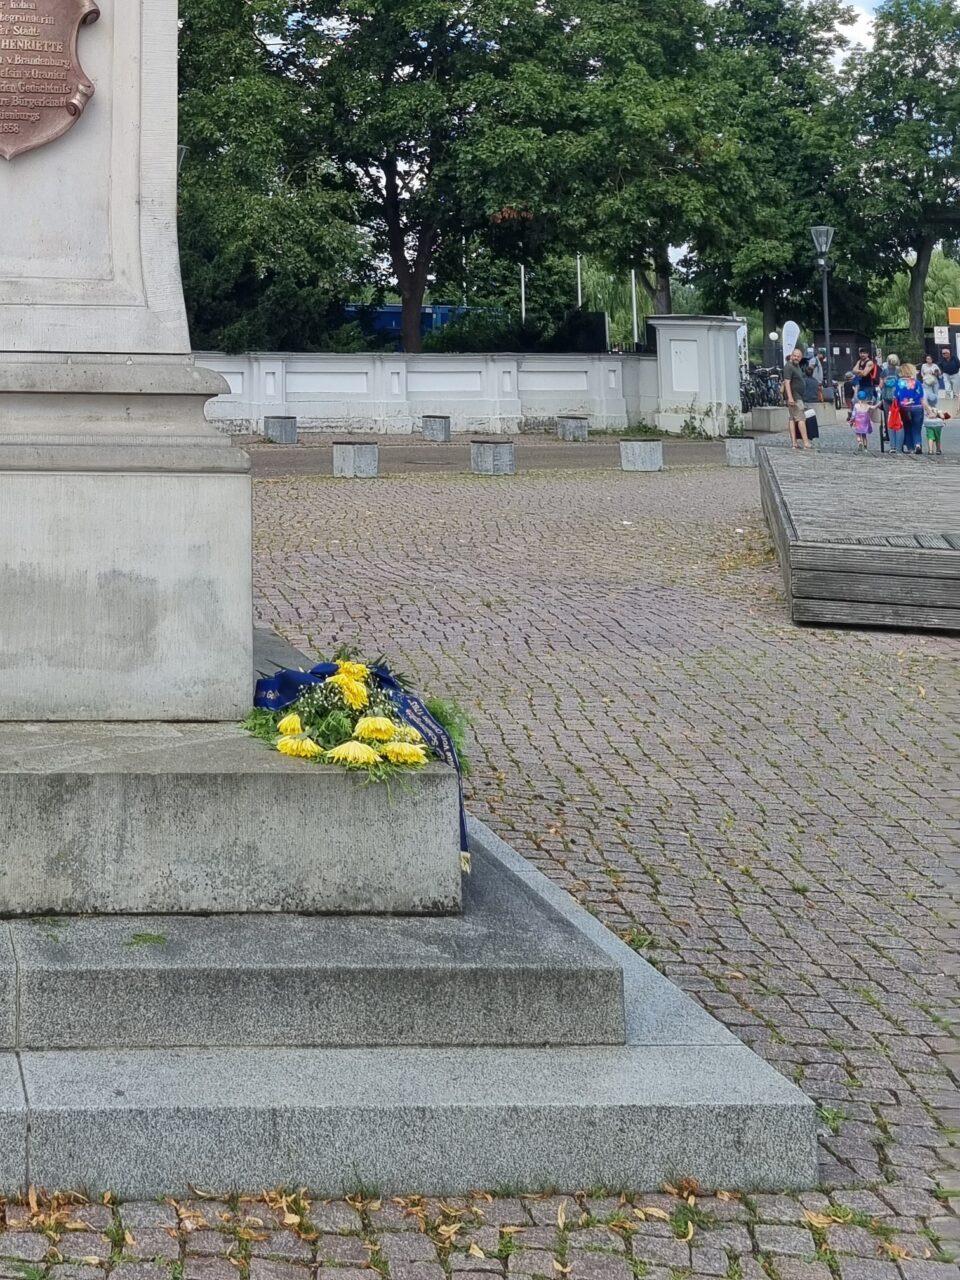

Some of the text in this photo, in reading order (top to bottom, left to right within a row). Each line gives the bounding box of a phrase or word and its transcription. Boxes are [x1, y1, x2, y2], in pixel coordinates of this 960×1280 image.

[10, 0, 36, 10] hohen
[1, 39, 64, 53] HENRIETTE
[32, 68, 67, 80] Oranien
[0, 123, 20, 134] 1858
